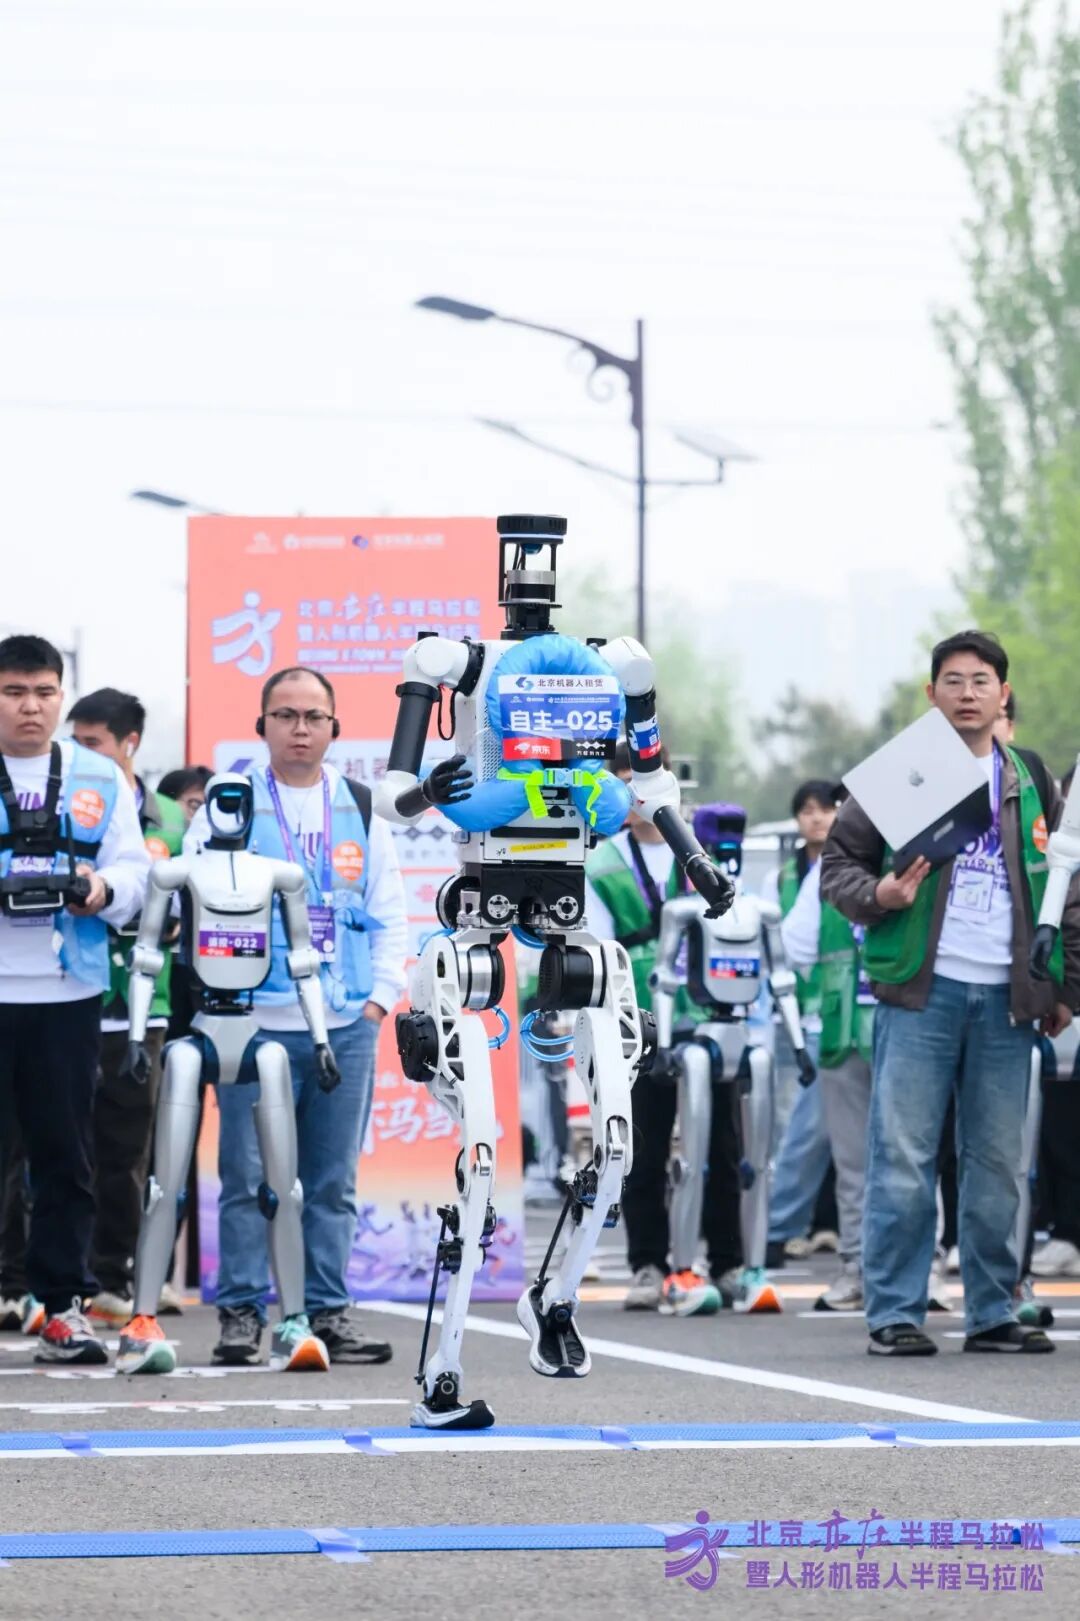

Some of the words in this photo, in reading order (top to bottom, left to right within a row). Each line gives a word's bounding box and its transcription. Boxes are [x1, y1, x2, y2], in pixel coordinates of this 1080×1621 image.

[537, 678, 604, 688] 北京机器人租赁
[510, 710, 613, 732] 自主-025
